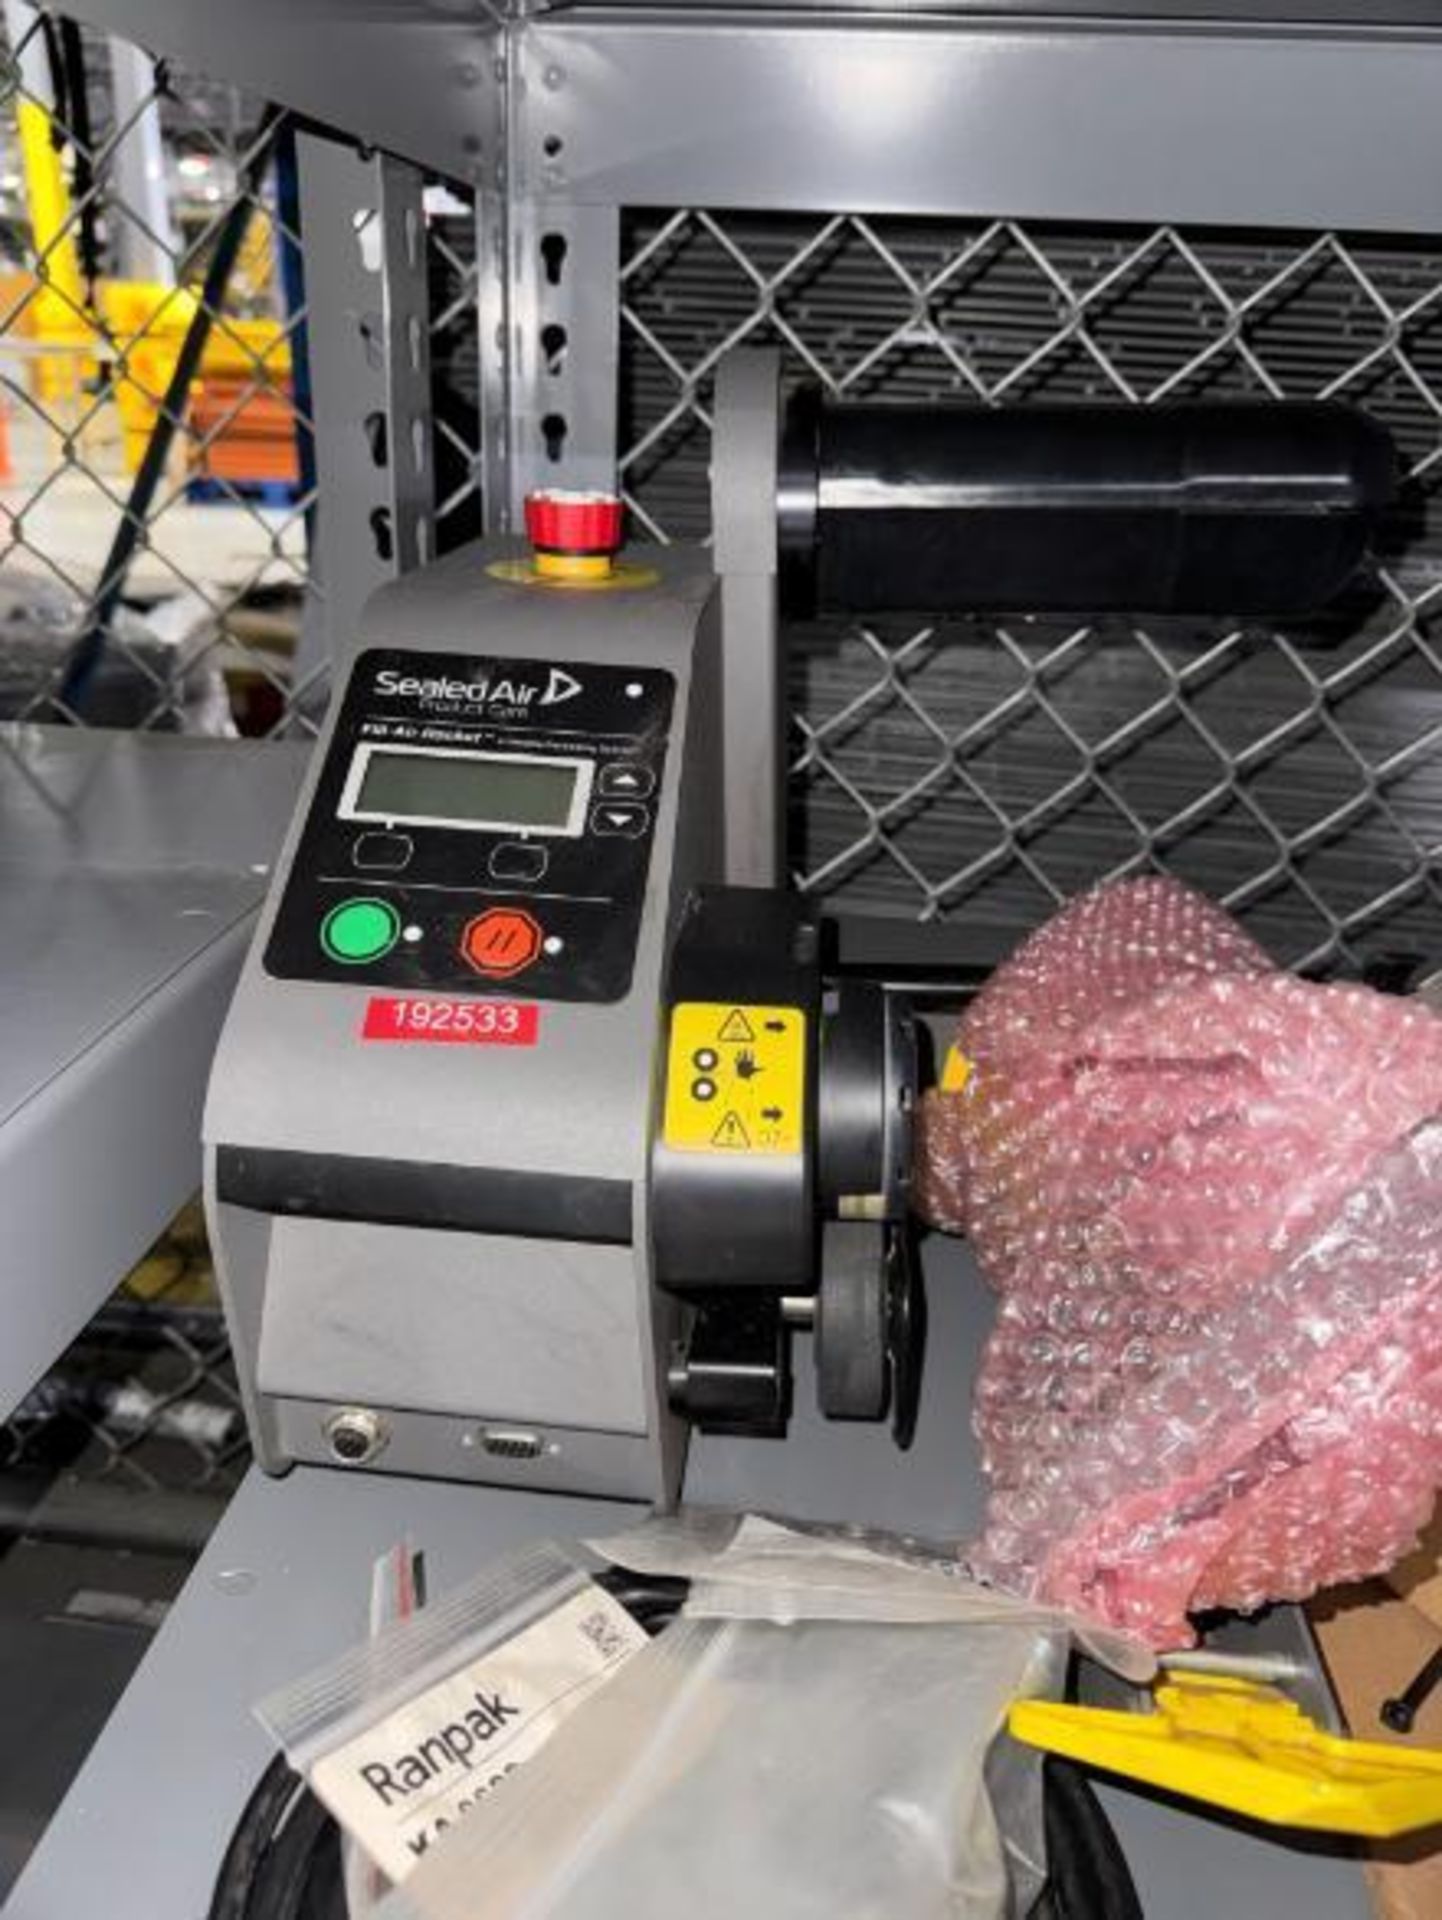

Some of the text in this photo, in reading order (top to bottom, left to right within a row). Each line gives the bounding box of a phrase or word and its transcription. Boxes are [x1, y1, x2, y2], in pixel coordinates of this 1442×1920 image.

[373, 670, 538, 705] Sealed Air
[393, 1001, 519, 1034] 192533
[360, 1692, 519, 1806] Ranpak
